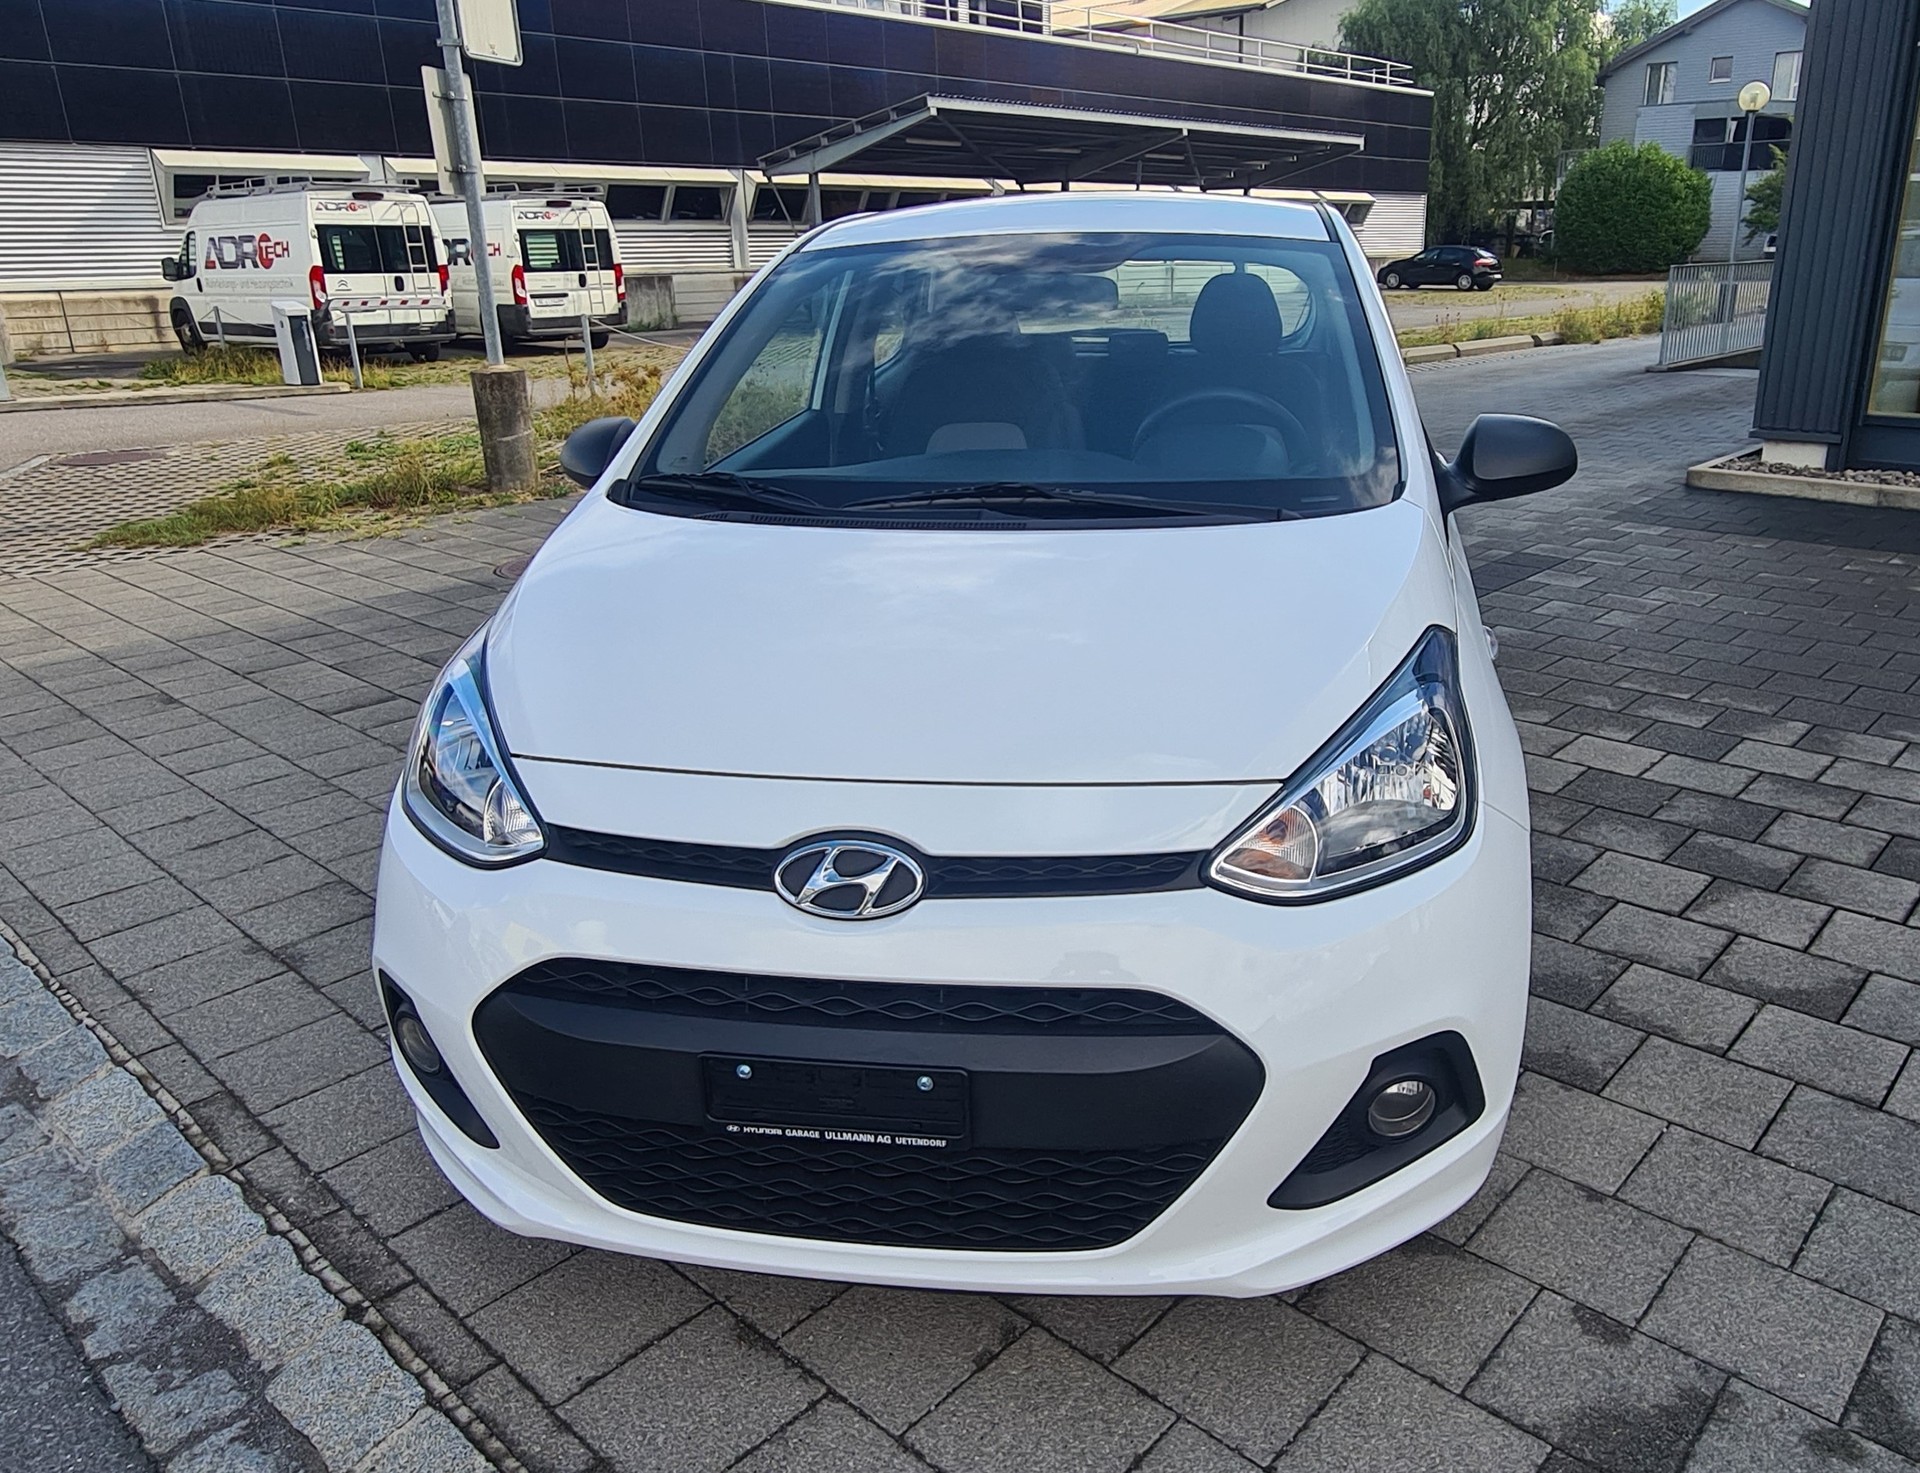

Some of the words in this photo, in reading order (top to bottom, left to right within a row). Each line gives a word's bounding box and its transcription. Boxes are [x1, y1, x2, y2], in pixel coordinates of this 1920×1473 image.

[743, 1126, 783, 1136] HYUNDAI
[785, 1128, 820, 1139] GARAGE
[824, 1130, 875, 1144] ULLMANN
[876, 1134, 892, 1145] AG
[895, 1136, 947, 1148] UETENDORF
